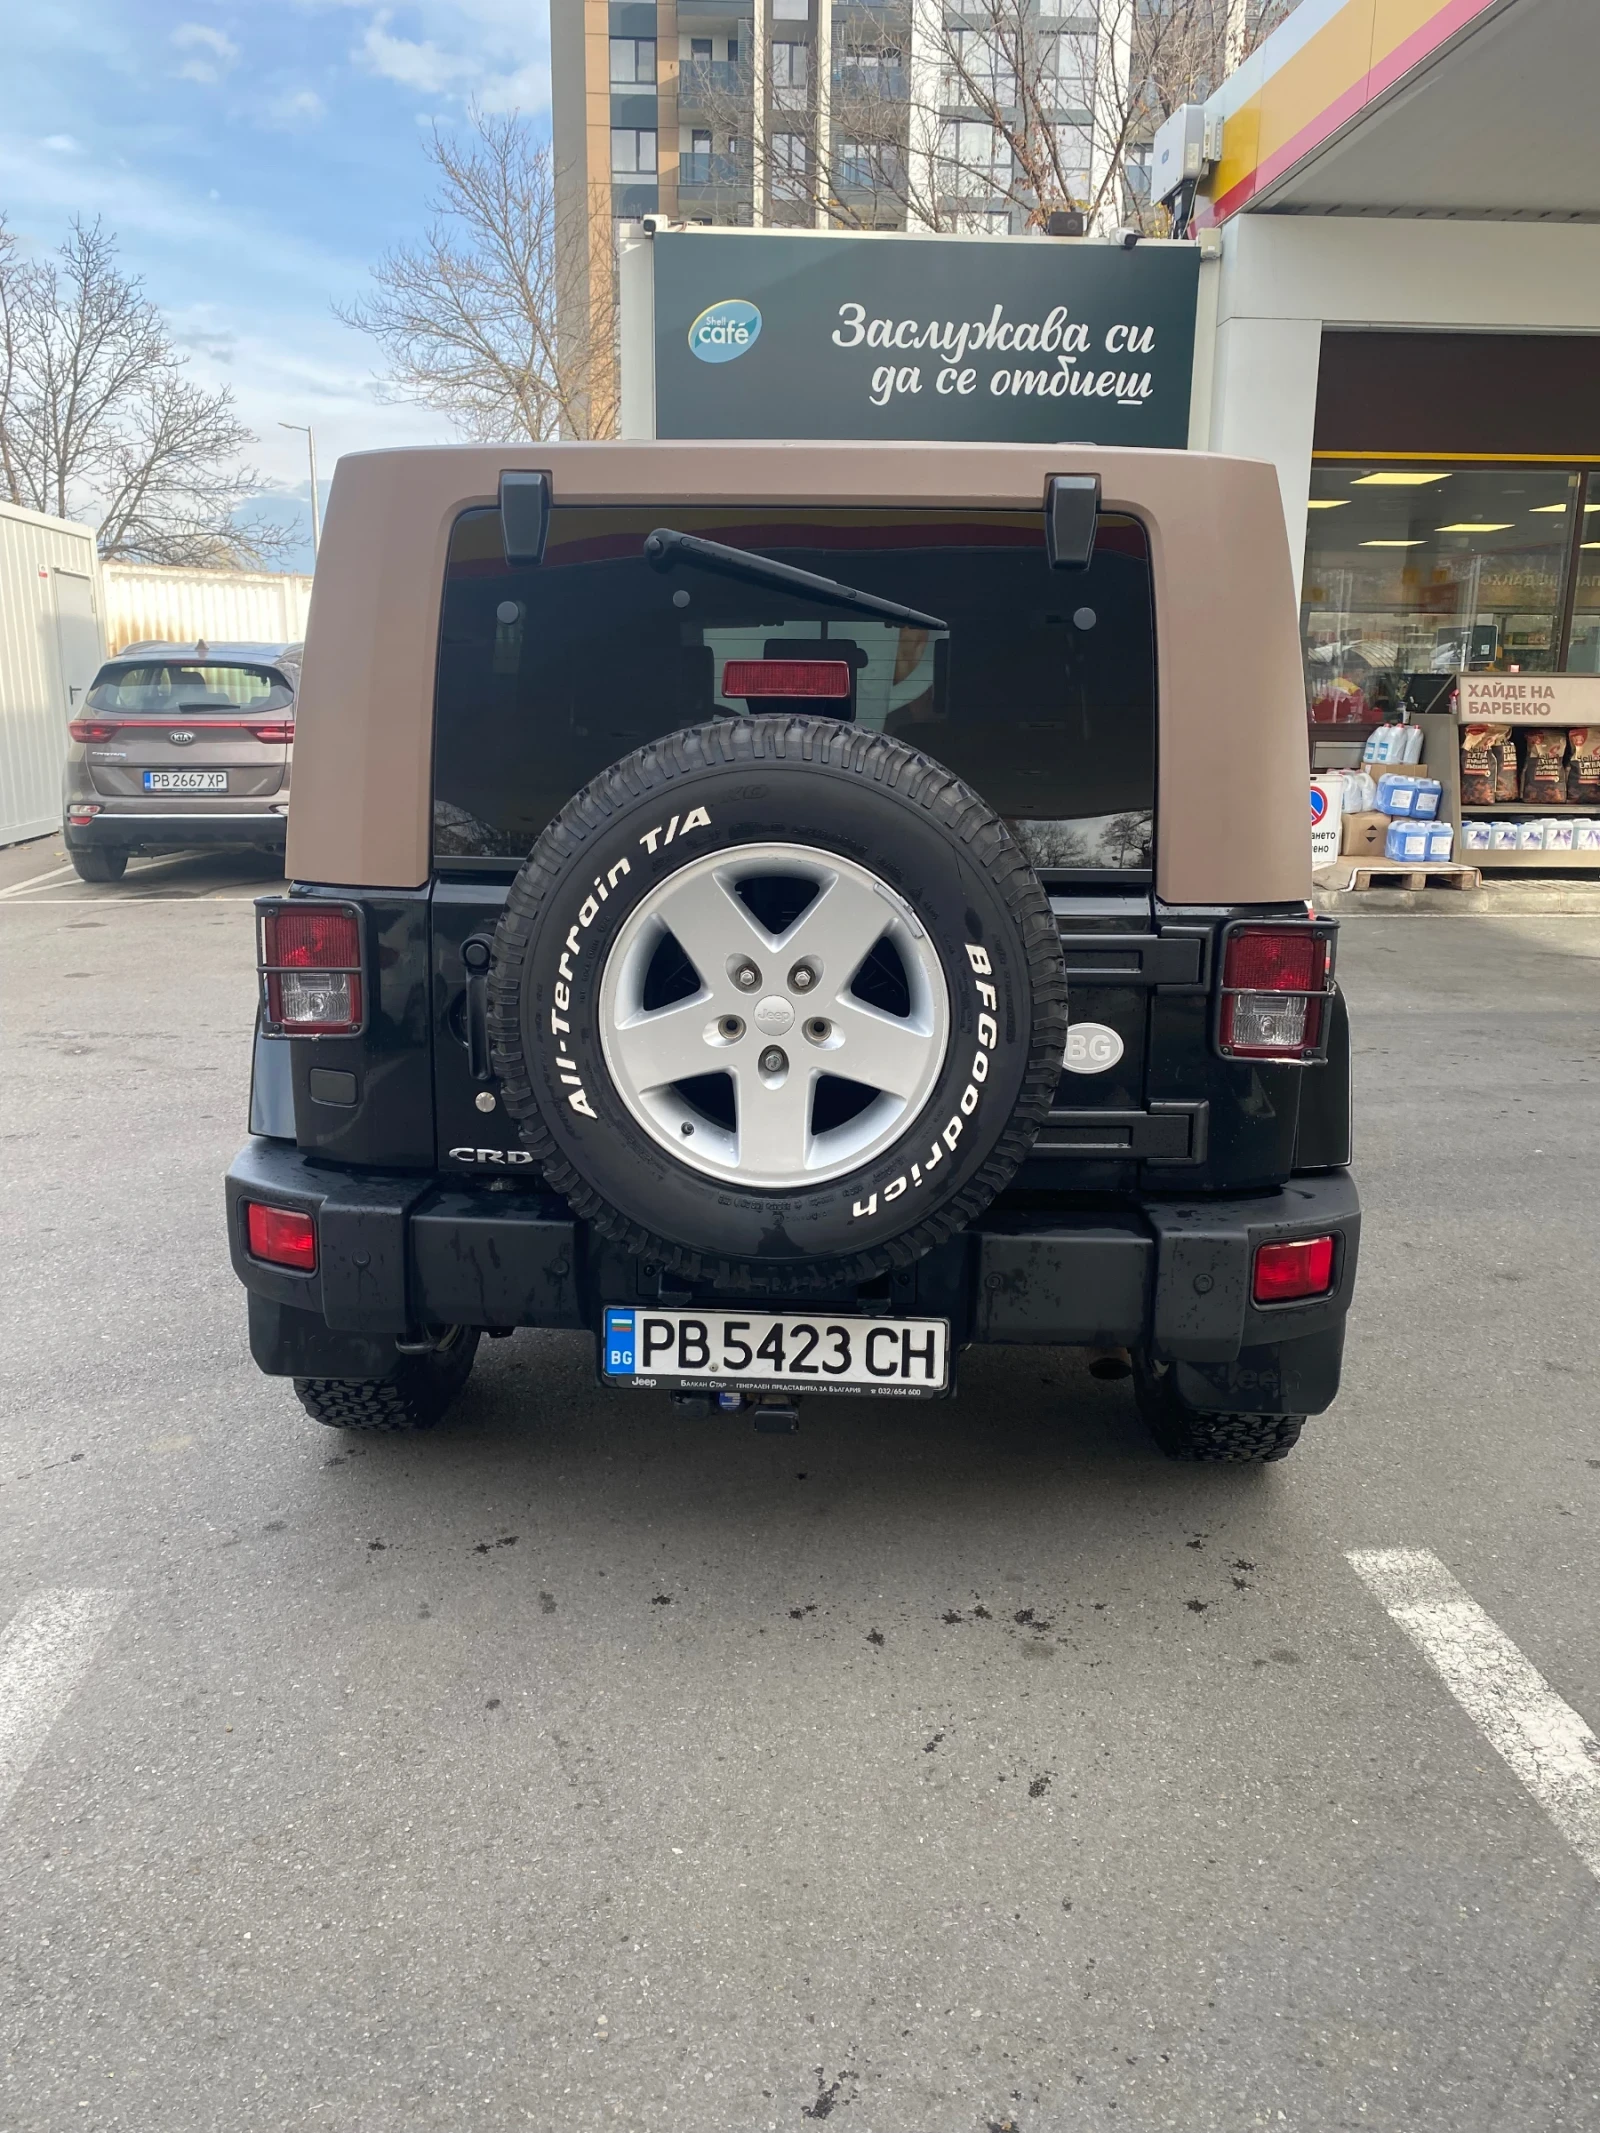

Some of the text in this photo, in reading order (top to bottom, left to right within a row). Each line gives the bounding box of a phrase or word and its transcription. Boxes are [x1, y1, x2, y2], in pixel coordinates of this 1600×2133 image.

[706, 316, 726, 326] Shell
[698, 320, 749, 345] café
[832, 302, 1156, 364] Заслужава си
[868, 355, 1153, 407] да се отбиеш
[1468, 682, 1555, 700] ХАЙДЕ НА
[1468, 701, 1551, 716] БАРБЕКЮ
[173, 733, 189, 741] KIA
[152, 774, 170, 787] PB
[172, 774, 204, 787] 2667
[207, 774, 224, 787] XP
[639, 806, 712, 855] T/A
[1312, 845, 1329, 853] ено
[757, 1008, 791, 1025] Jeep
[1067, 1033, 1112, 1061] BG
[853, 943, 998, 1218] BFGoodrich
[448, 1147, 534, 1165] CRD
[610, 1350, 633, 1365] BG
[642, 1318, 936, 1380] PB 5423 CH
[632, 1376, 657, 1388] Jeep
[878, 1387, 907, 1396] 032/654
[908, 1388, 921, 1396] 600
